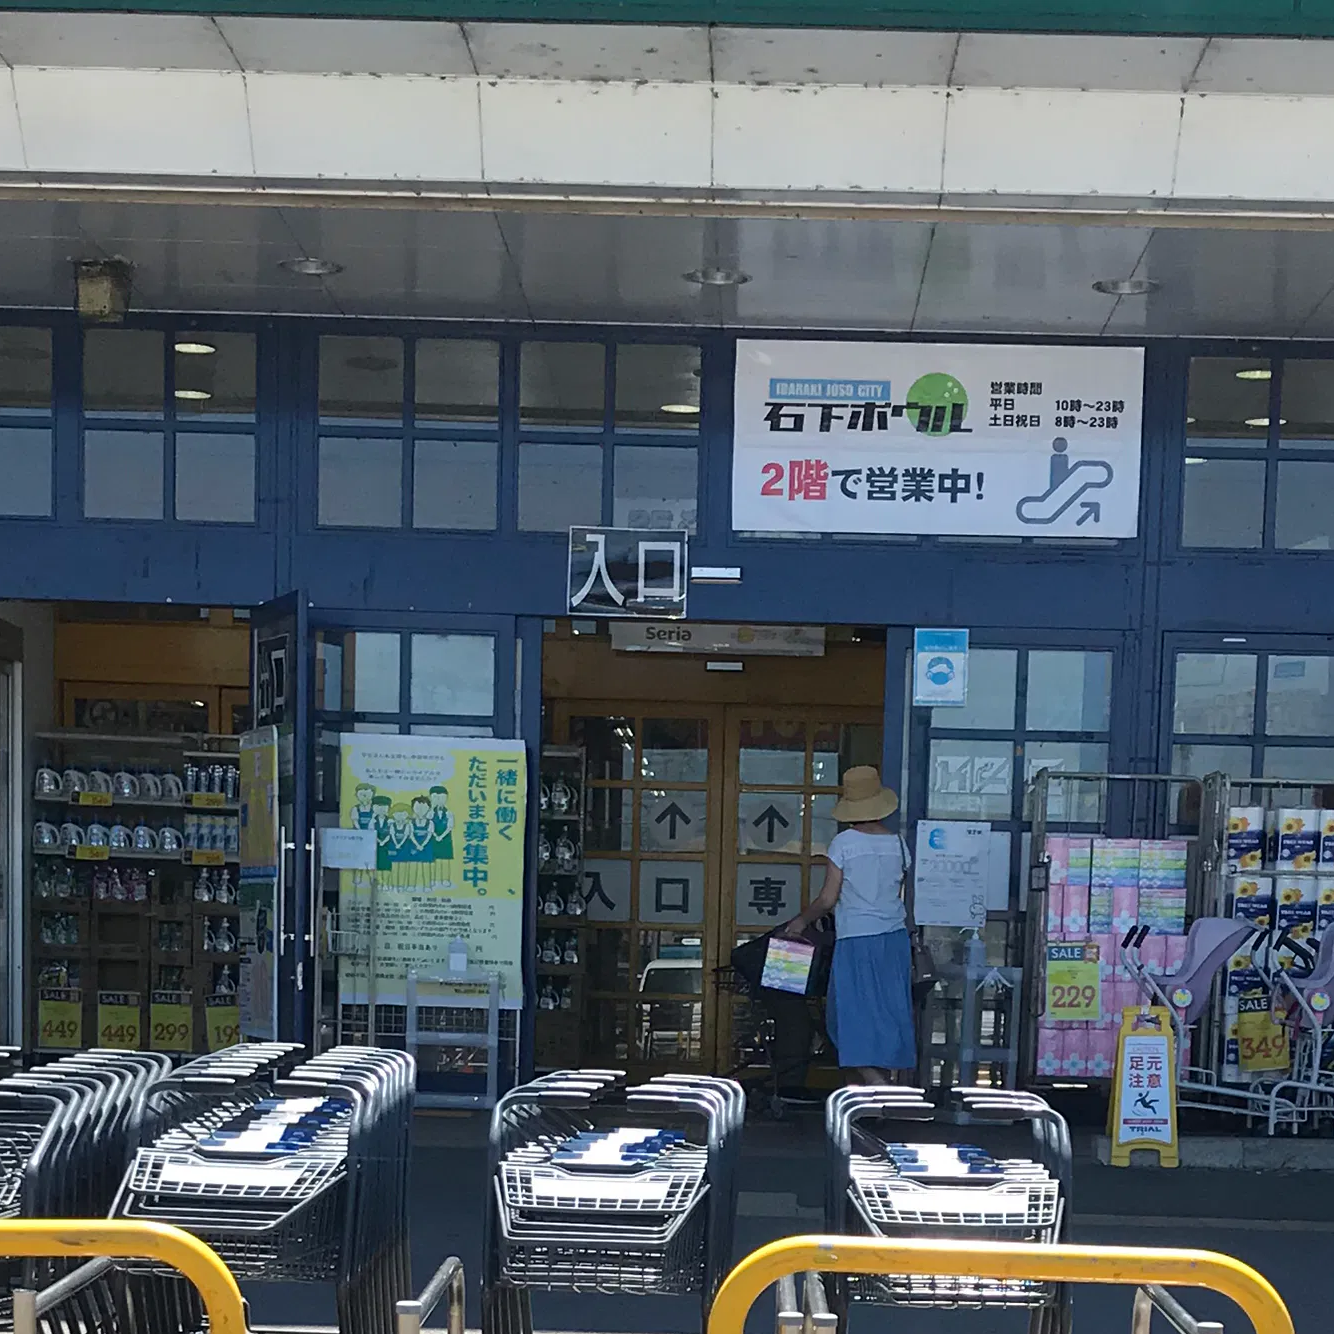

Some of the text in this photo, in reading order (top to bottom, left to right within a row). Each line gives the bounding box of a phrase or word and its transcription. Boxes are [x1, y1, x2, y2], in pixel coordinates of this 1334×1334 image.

[857, 383, 883, 398] CITY
[989, 380, 1043, 396] 営業時間
[989, 397, 1015, 411] 平日
[988, 413, 1042, 428] 土日祝日
[570, 533, 681, 608] 入口
[644, 626, 693, 643] Seria
[494, 756, 520, 842] 一緒に働く
[1050, 947, 1082, 960] SALE
[100, 993, 126, 1004] SALE
[153, 993, 178, 1003] SALE
[1050, 985, 1097, 1009] 229
[1238, 998, 1269, 1012] SALE
[41, 1019, 79, 1039] 449
[100, 1023, 137, 1043] 449
[153, 1022, 189, 1042] 299
[1240, 1033, 1287, 1061] 349
[1128, 1055, 1163, 1072] 足元
[1128, 1072, 1163, 1089] 注意
[1128, 1125, 1163, 1135] TRIAL
